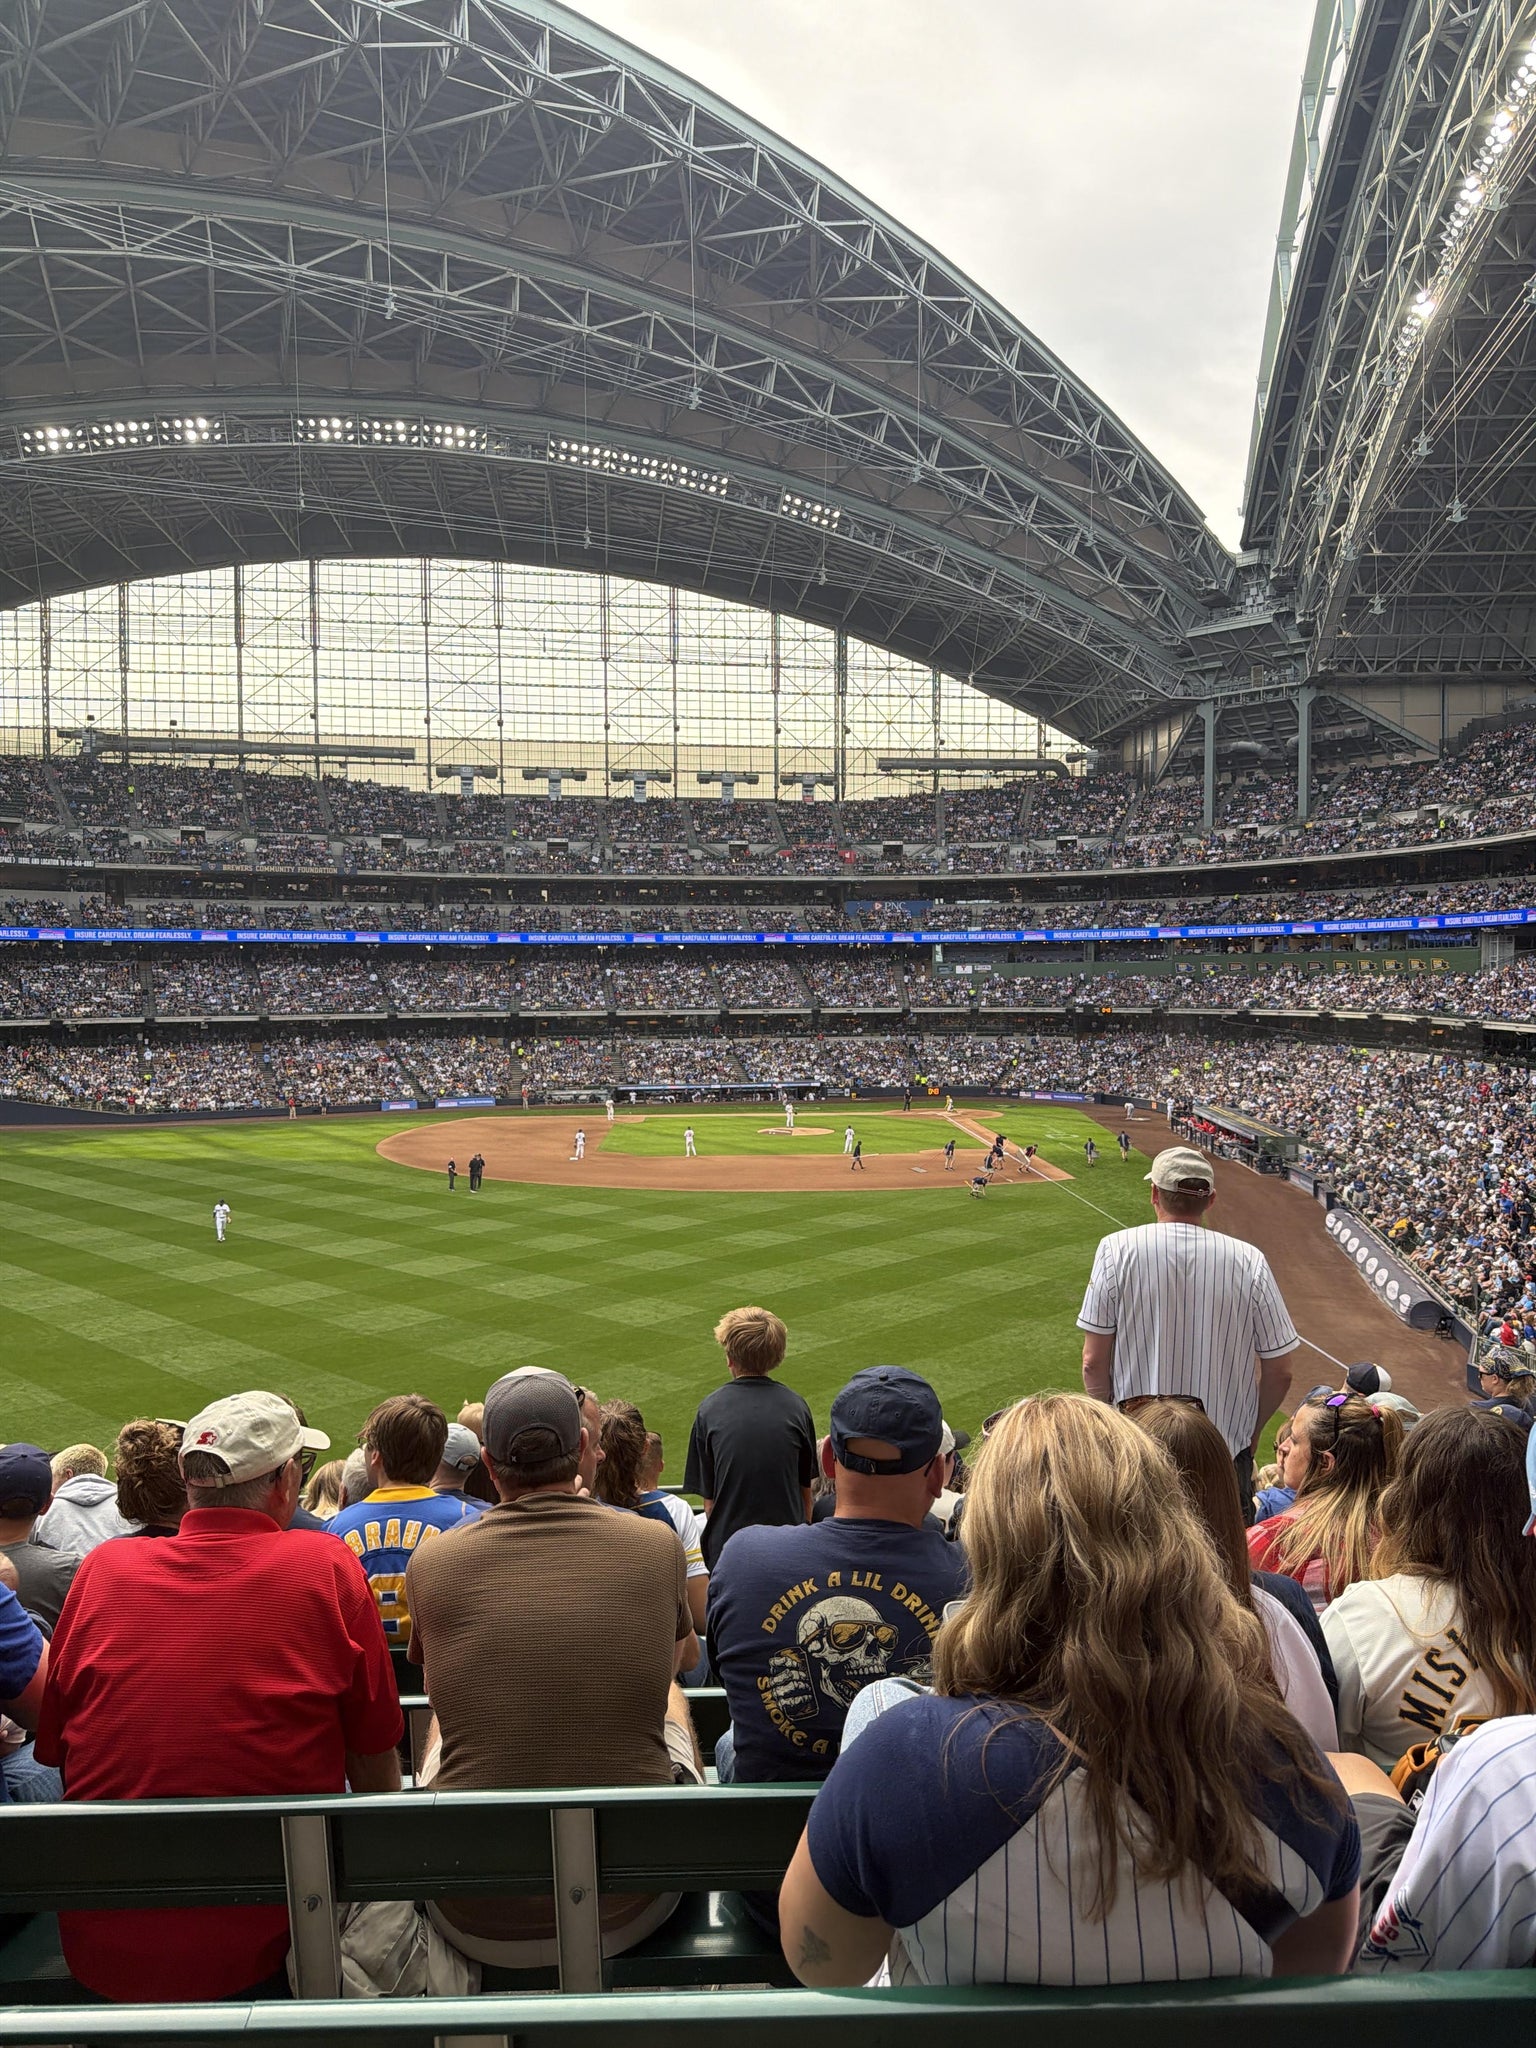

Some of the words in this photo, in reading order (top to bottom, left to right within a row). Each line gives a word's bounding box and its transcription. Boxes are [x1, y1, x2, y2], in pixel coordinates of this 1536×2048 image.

[222, 864, 253, 872] BREWERS
[256, 865, 295, 873] COMMUNITY
[297, 866, 338, 874] FOUNDATION
[884, 901, 906, 911] PNC
[236, 932, 258, 940] INSURE
[292, 932, 310, 940] DREAM
[1188, 928, 1207, 936] INSURE
[528, 934, 547, 942] INSURE
[577, 934, 594, 942] DREAM
[663, 934, 680, 942] INSURE
[710, 934, 727, 942] DREAM
[792, 934, 810, 942] INSURE
[838, 934, 855, 942] DREAM
[762, 1577, 819, 1634] DRINK
[827, 1571, 841, 1588] A
[851, 1570, 883, 1591] LIL
[757, 1676, 808, 1747] SMOKE
[812, 1739, 829, 1755] A
